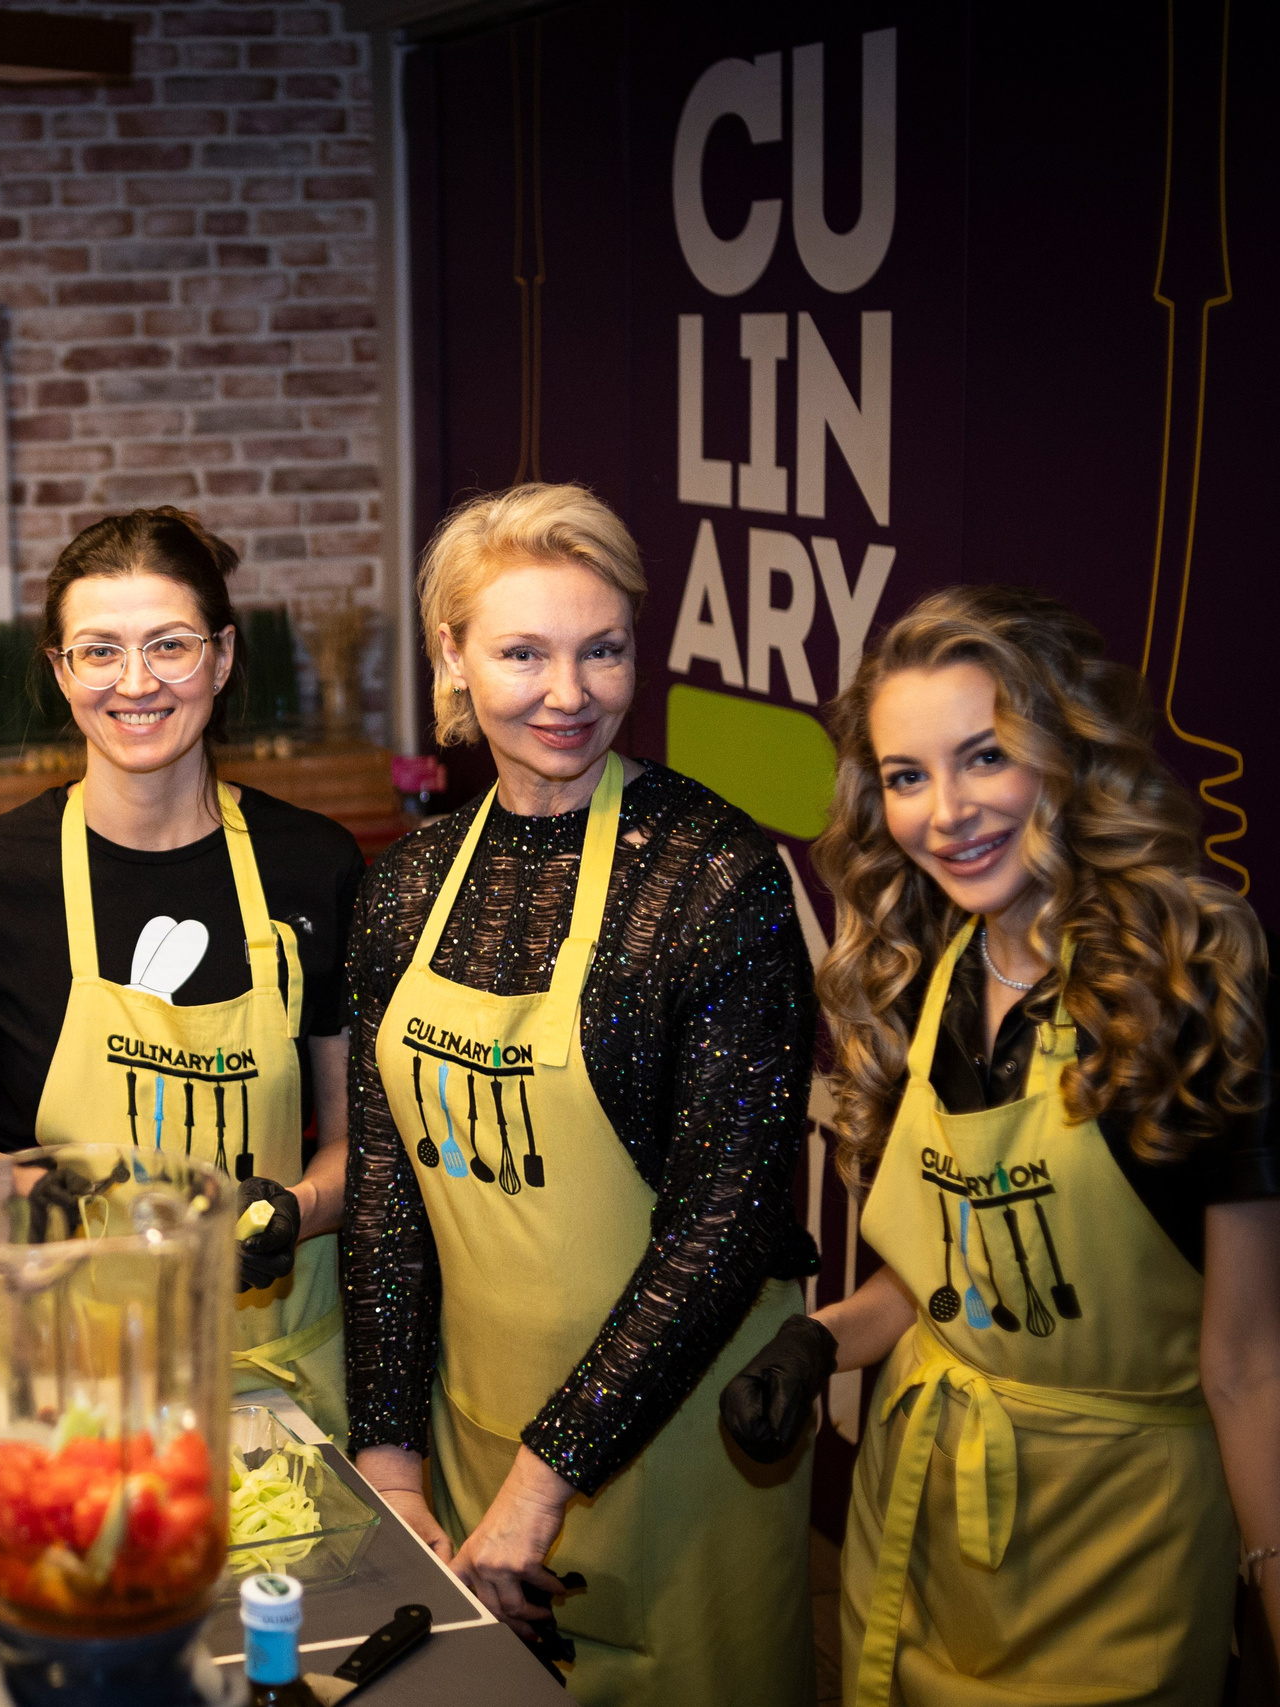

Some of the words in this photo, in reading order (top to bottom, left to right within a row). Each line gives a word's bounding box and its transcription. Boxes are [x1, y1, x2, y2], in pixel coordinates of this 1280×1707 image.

[673, 27, 897, 297] CU
[678, 311, 892, 527] LIN
[667, 518, 896, 706] ARY
